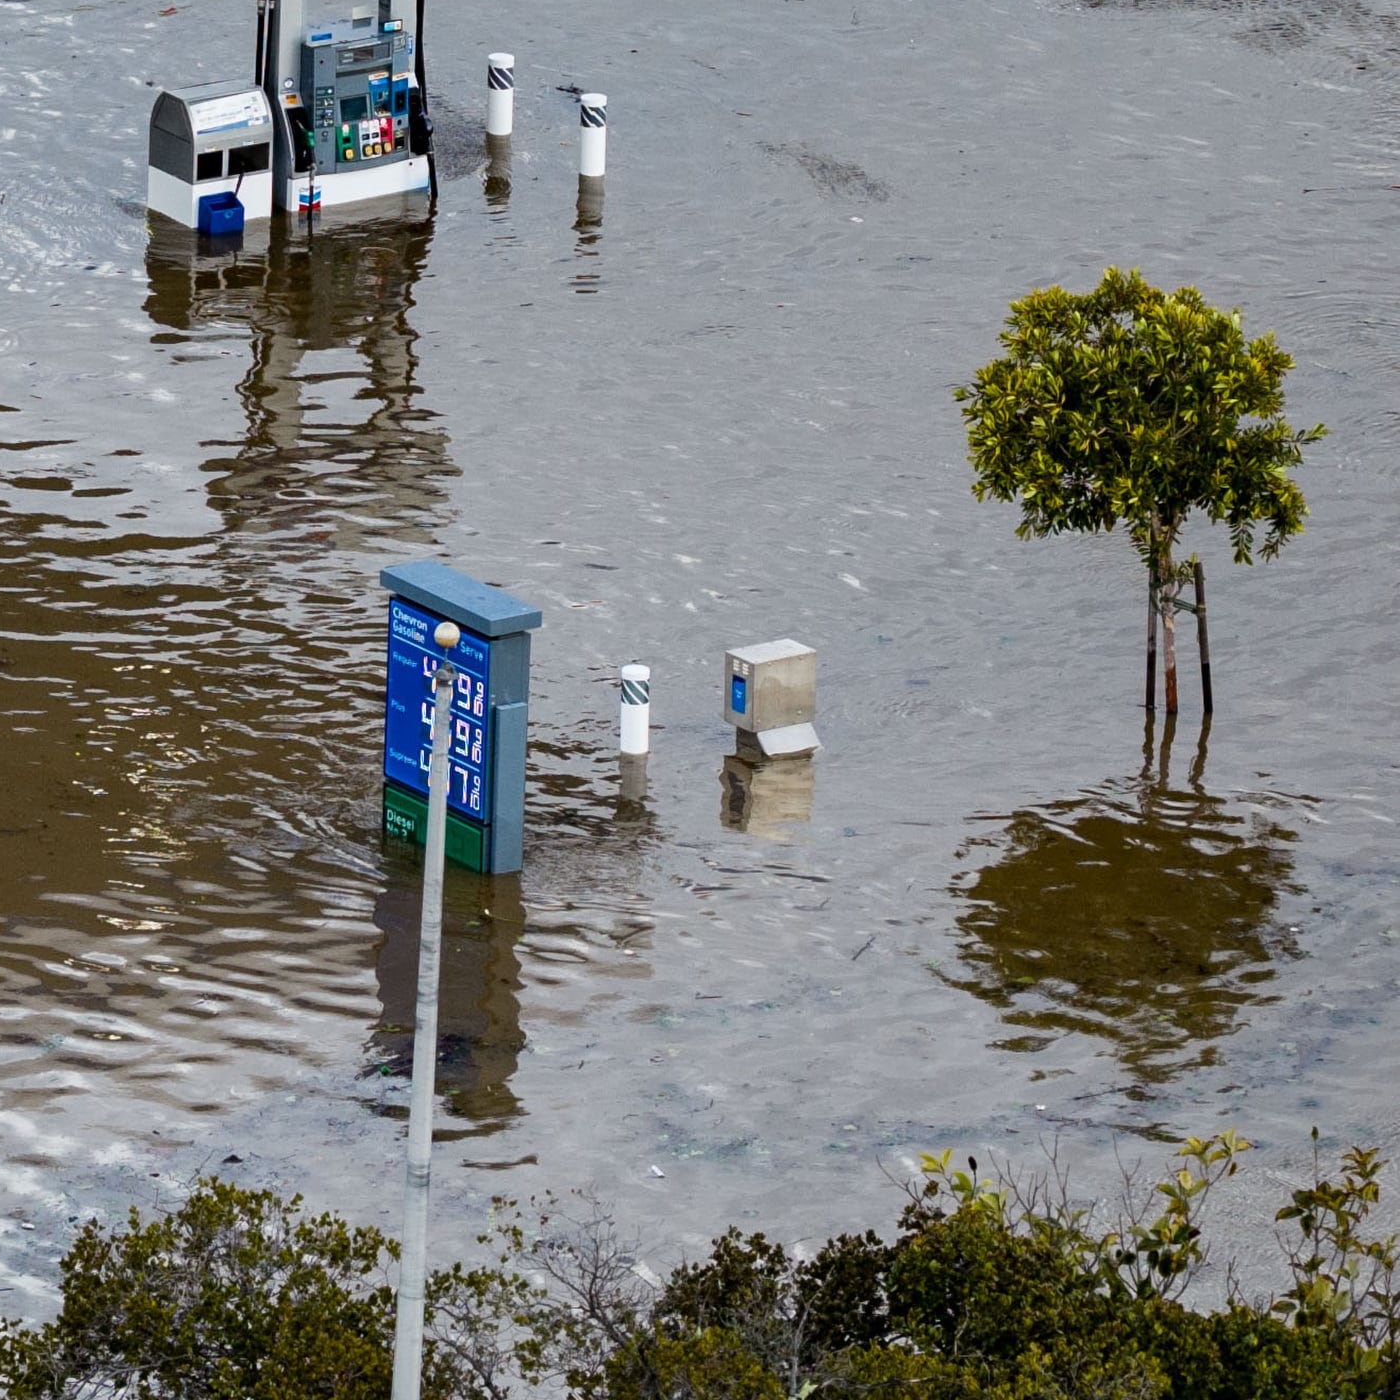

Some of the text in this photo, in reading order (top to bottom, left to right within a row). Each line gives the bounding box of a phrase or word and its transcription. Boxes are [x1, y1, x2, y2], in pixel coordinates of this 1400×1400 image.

[392, 607, 428, 632] Chevron
[392, 619, 425, 644] Gasoline
[460, 641, 484, 662] Serve
[423, 656, 471, 710] 49
[422, 702, 470, 756] 49
[420, 750, 469, 804] 47
[386, 809, 415, 831] Diesel
